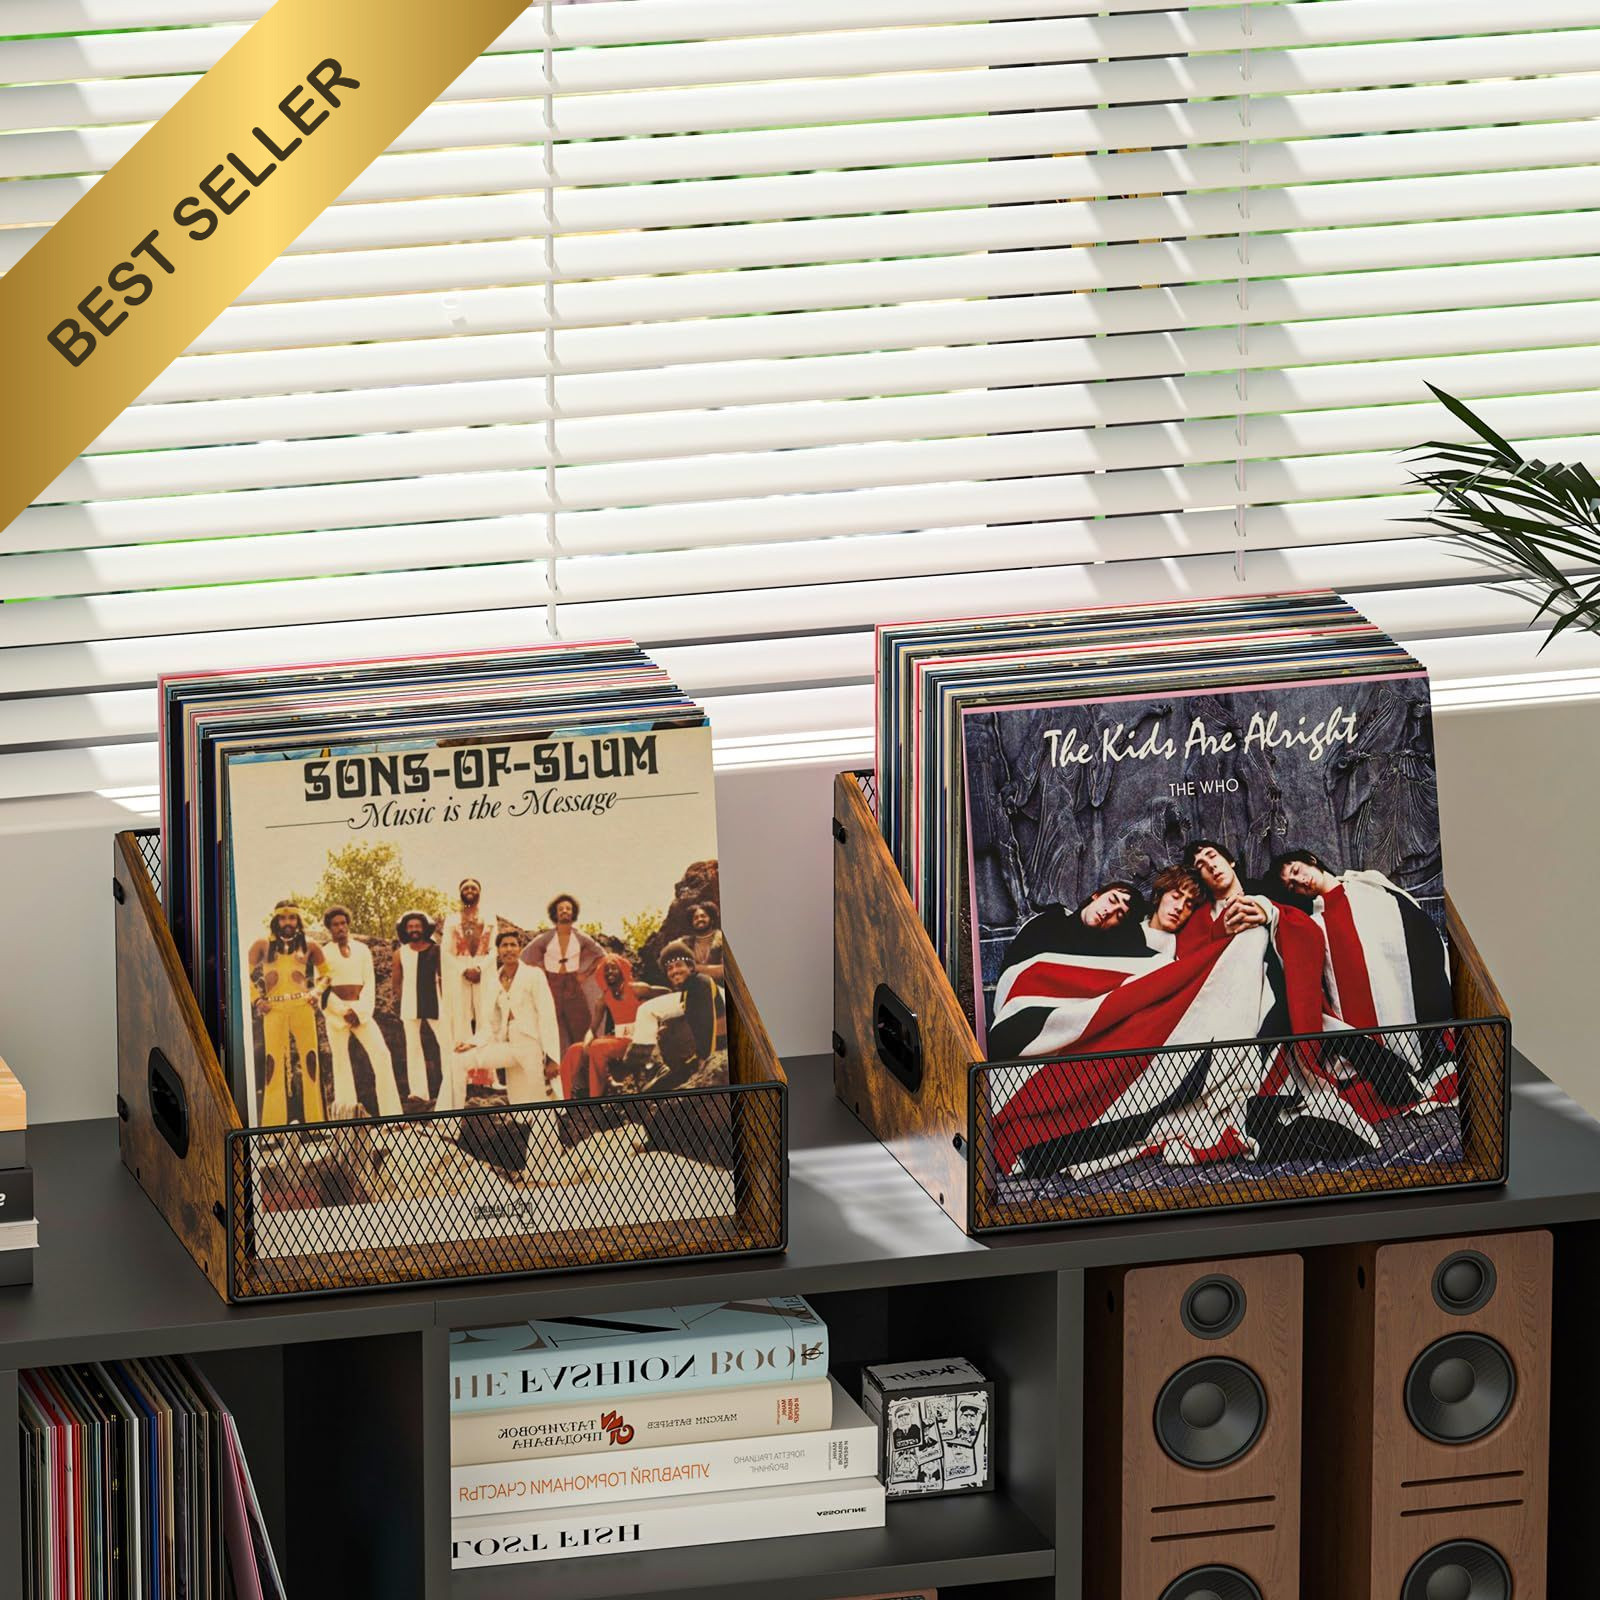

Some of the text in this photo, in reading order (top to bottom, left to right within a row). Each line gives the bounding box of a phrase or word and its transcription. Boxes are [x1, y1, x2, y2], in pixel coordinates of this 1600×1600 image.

[1044, 706, 1359, 768] The Kids Are Alright
[304, 735, 659, 801] SONS-OF-SLUM
[1169, 778, 1239, 797] THE WHO
[347, 788, 617, 830] Music is the Message
